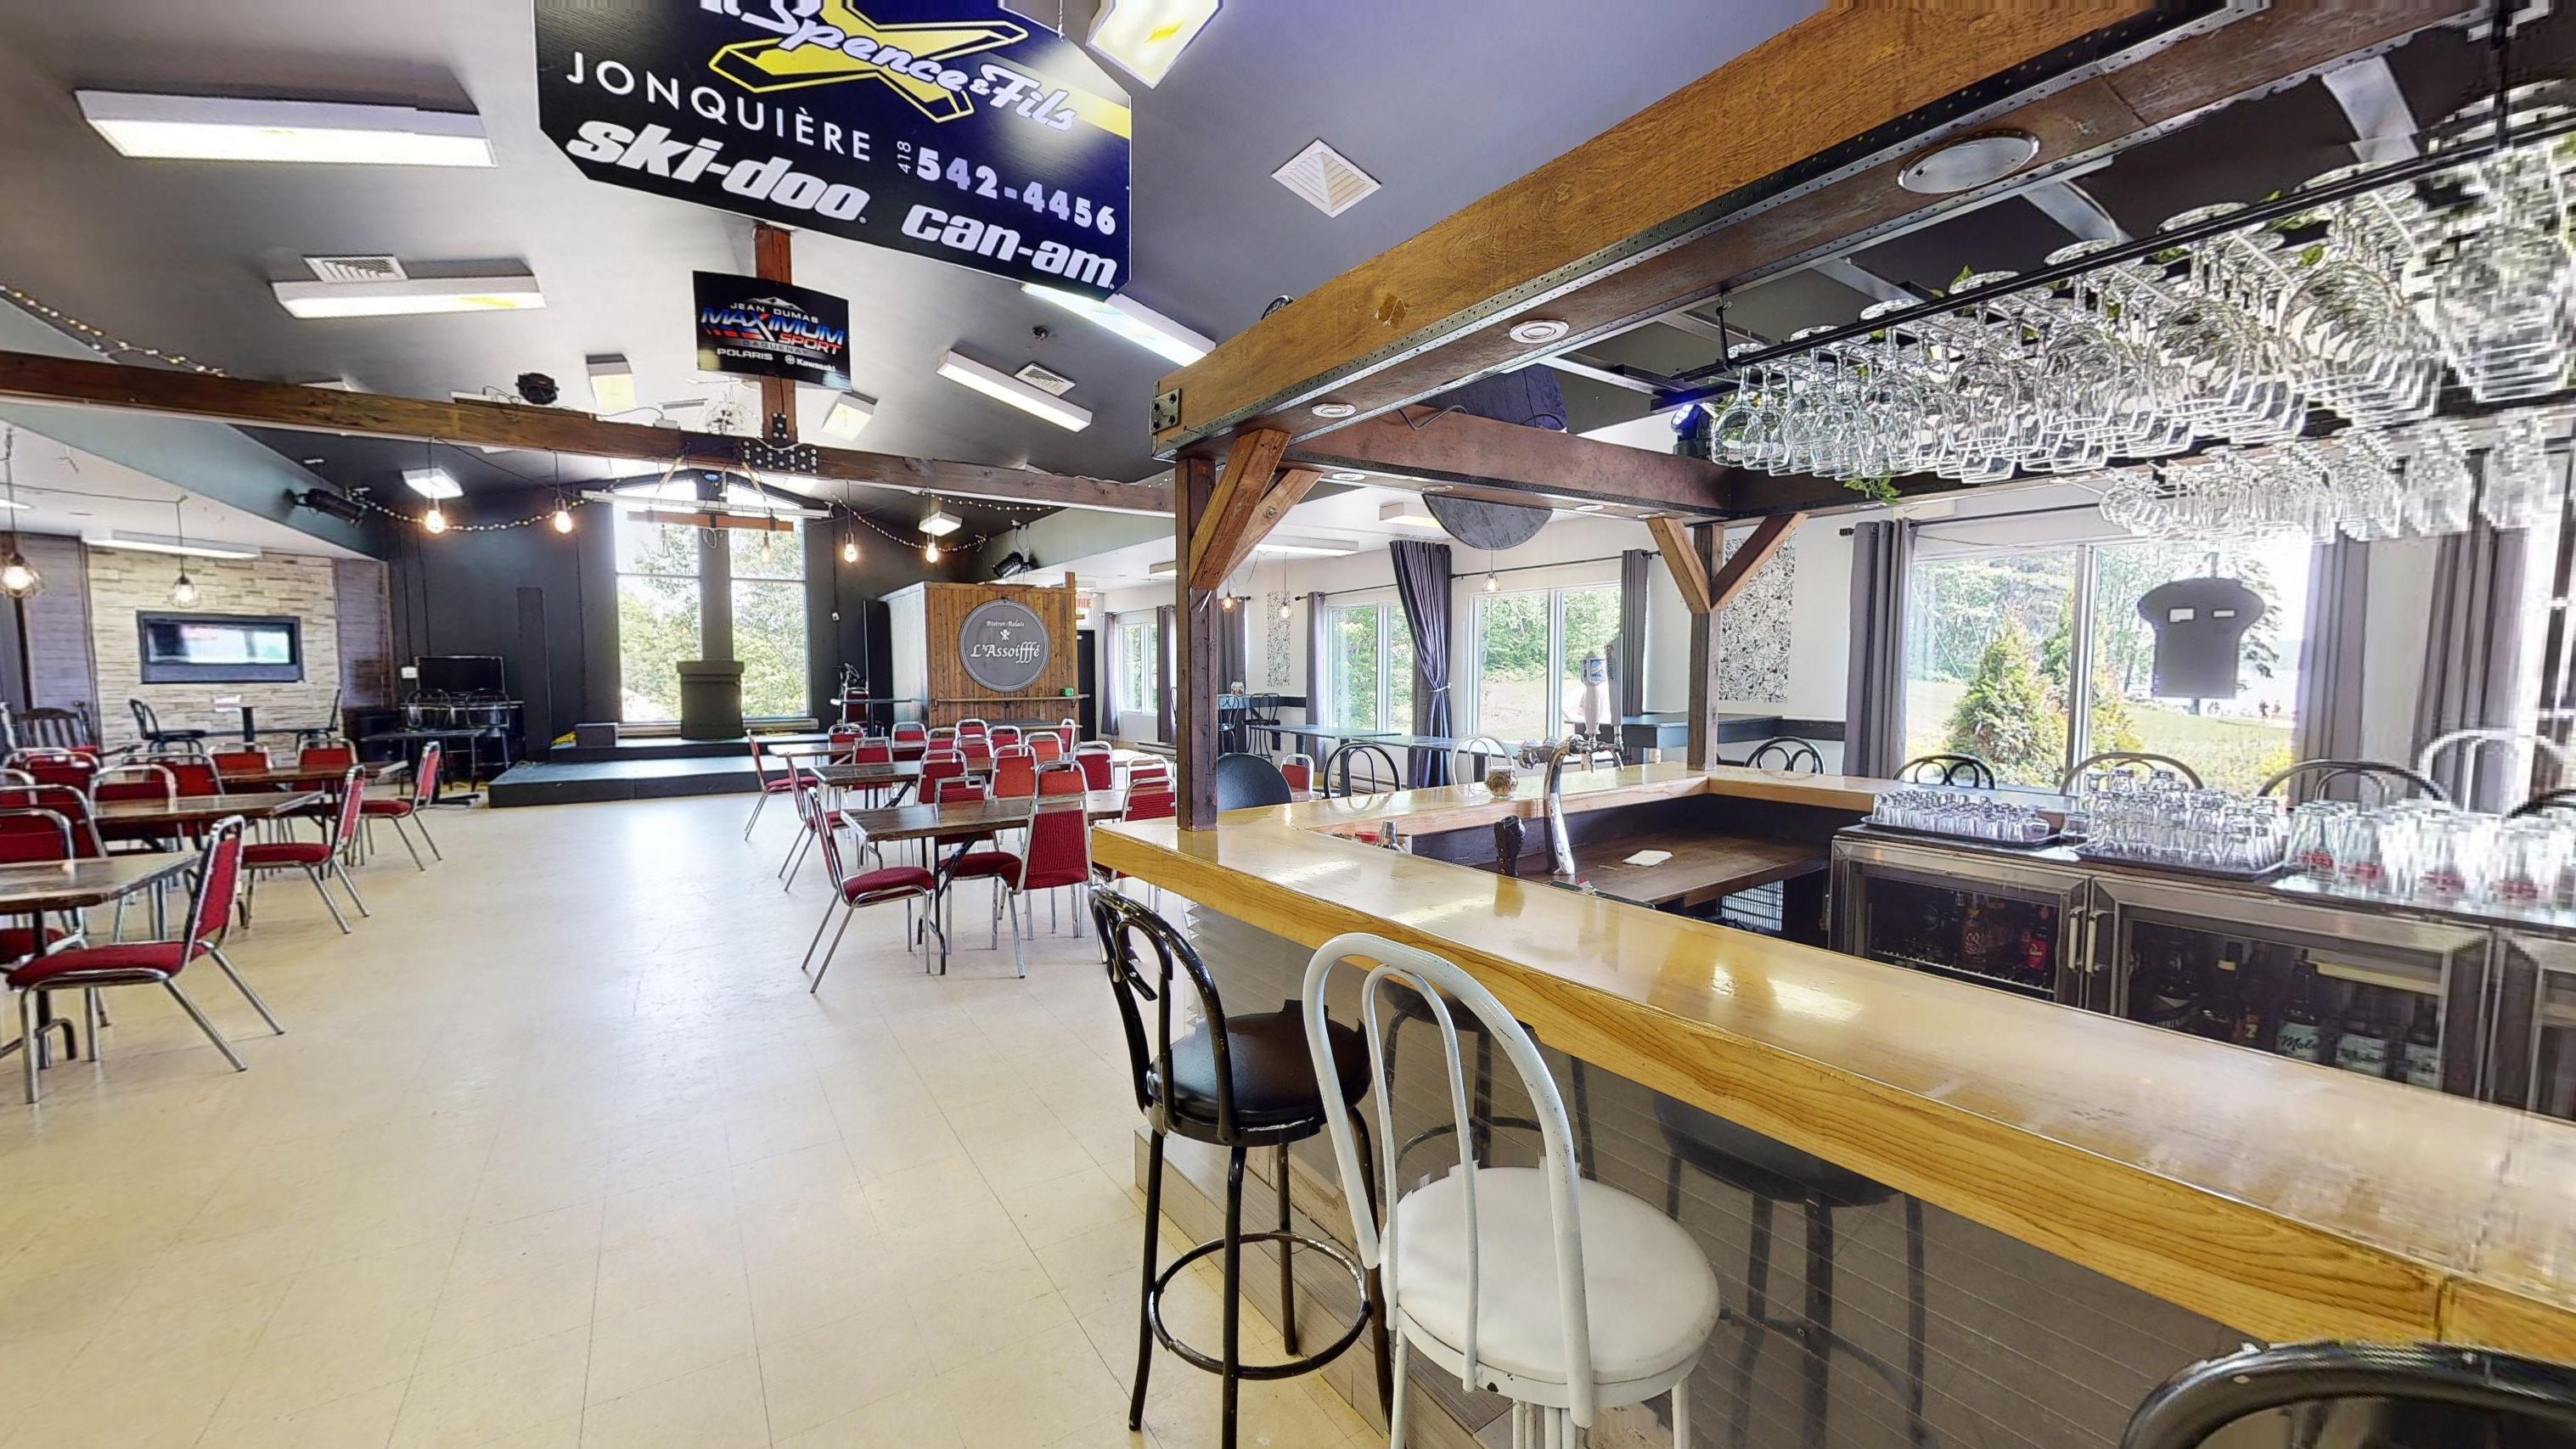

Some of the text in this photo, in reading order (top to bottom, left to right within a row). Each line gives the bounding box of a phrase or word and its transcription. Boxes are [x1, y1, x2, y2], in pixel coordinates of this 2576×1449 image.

[566, 52, 871, 162] JONQUIÈRE
[565, 119, 870, 222] ski-doo
[897, 140, 1116, 235] 418 542-4456
[701, 307, 844, 345] MAXIMUM
[729, 302, 818, 323] JEAN DUMAS
[717, 348, 773, 362] POLARIS
[779, 332, 841, 355] SPORT
[796, 358, 835, 372] Kawasaki
